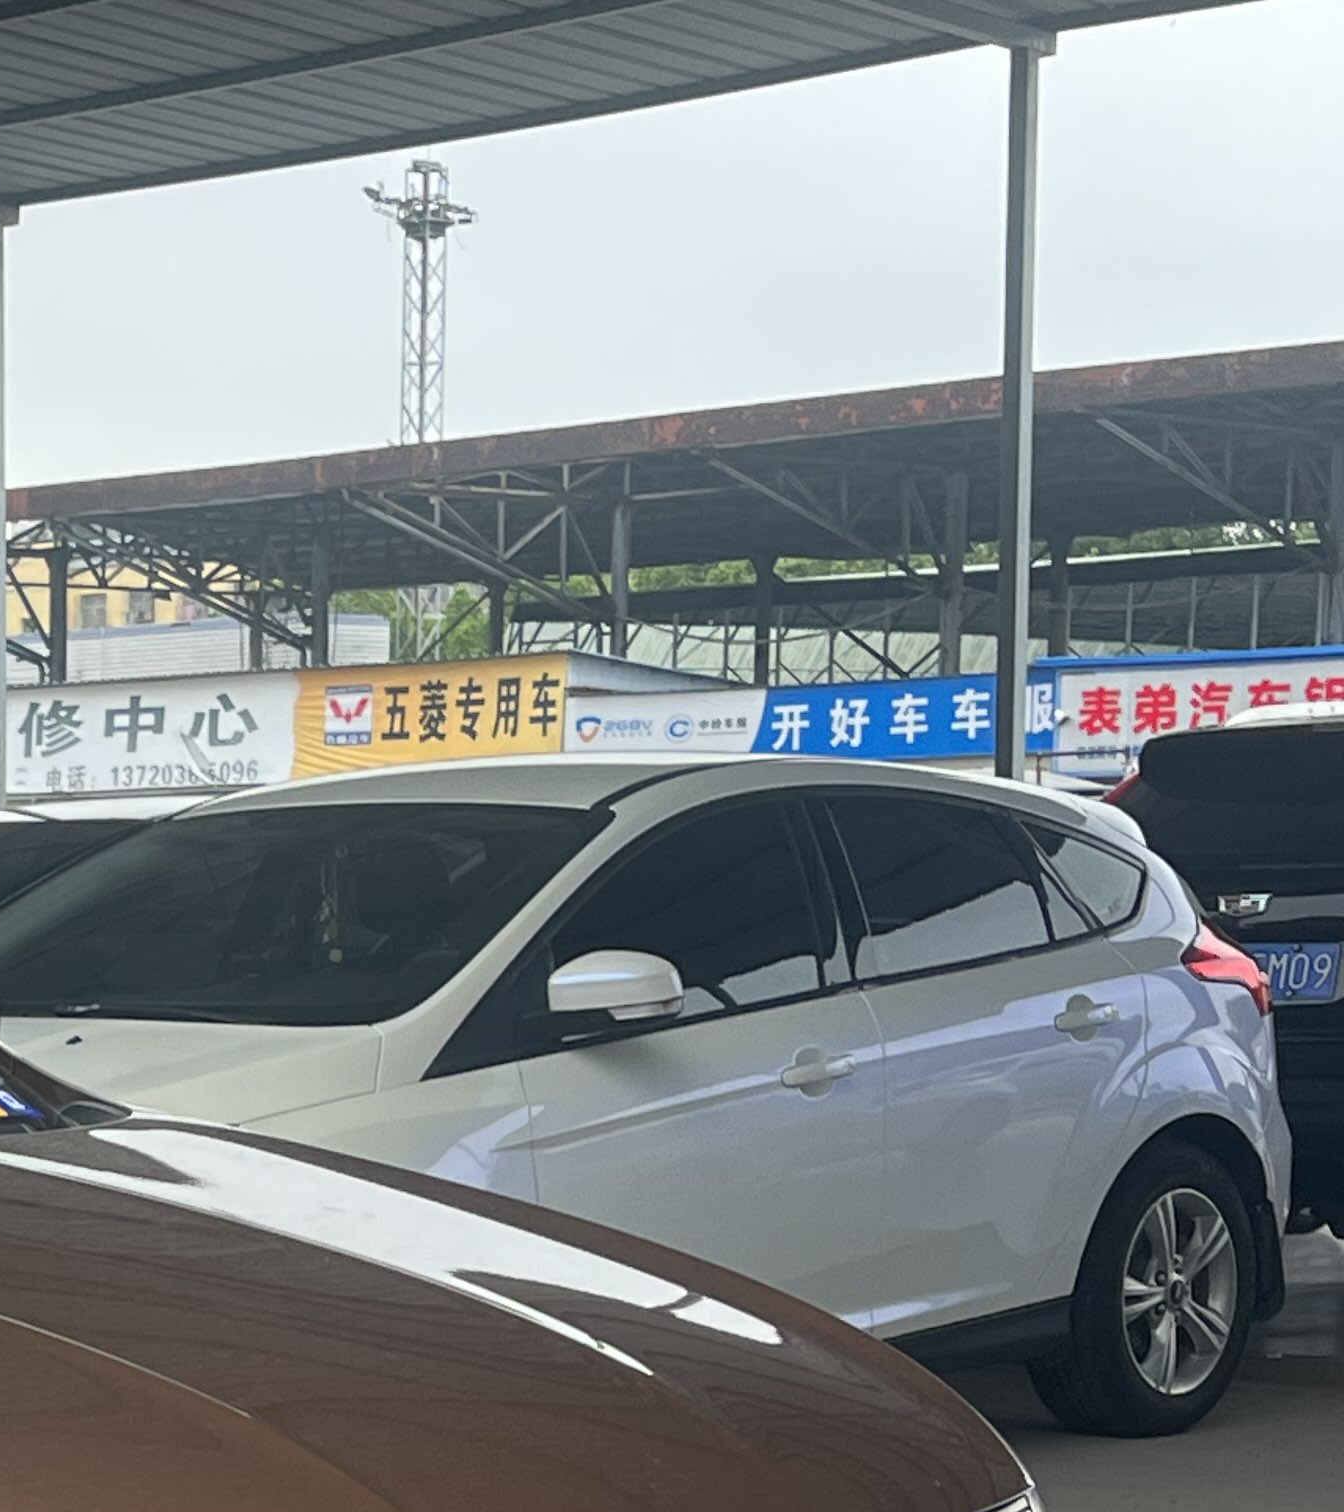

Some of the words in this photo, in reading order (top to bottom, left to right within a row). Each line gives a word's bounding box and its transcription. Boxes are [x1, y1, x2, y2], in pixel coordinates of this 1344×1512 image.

[381, 673, 561, 743] 五菱专用车
[771, 683, 1054, 751] 开好车车服
[1252, 953, 1333, 990] M09
